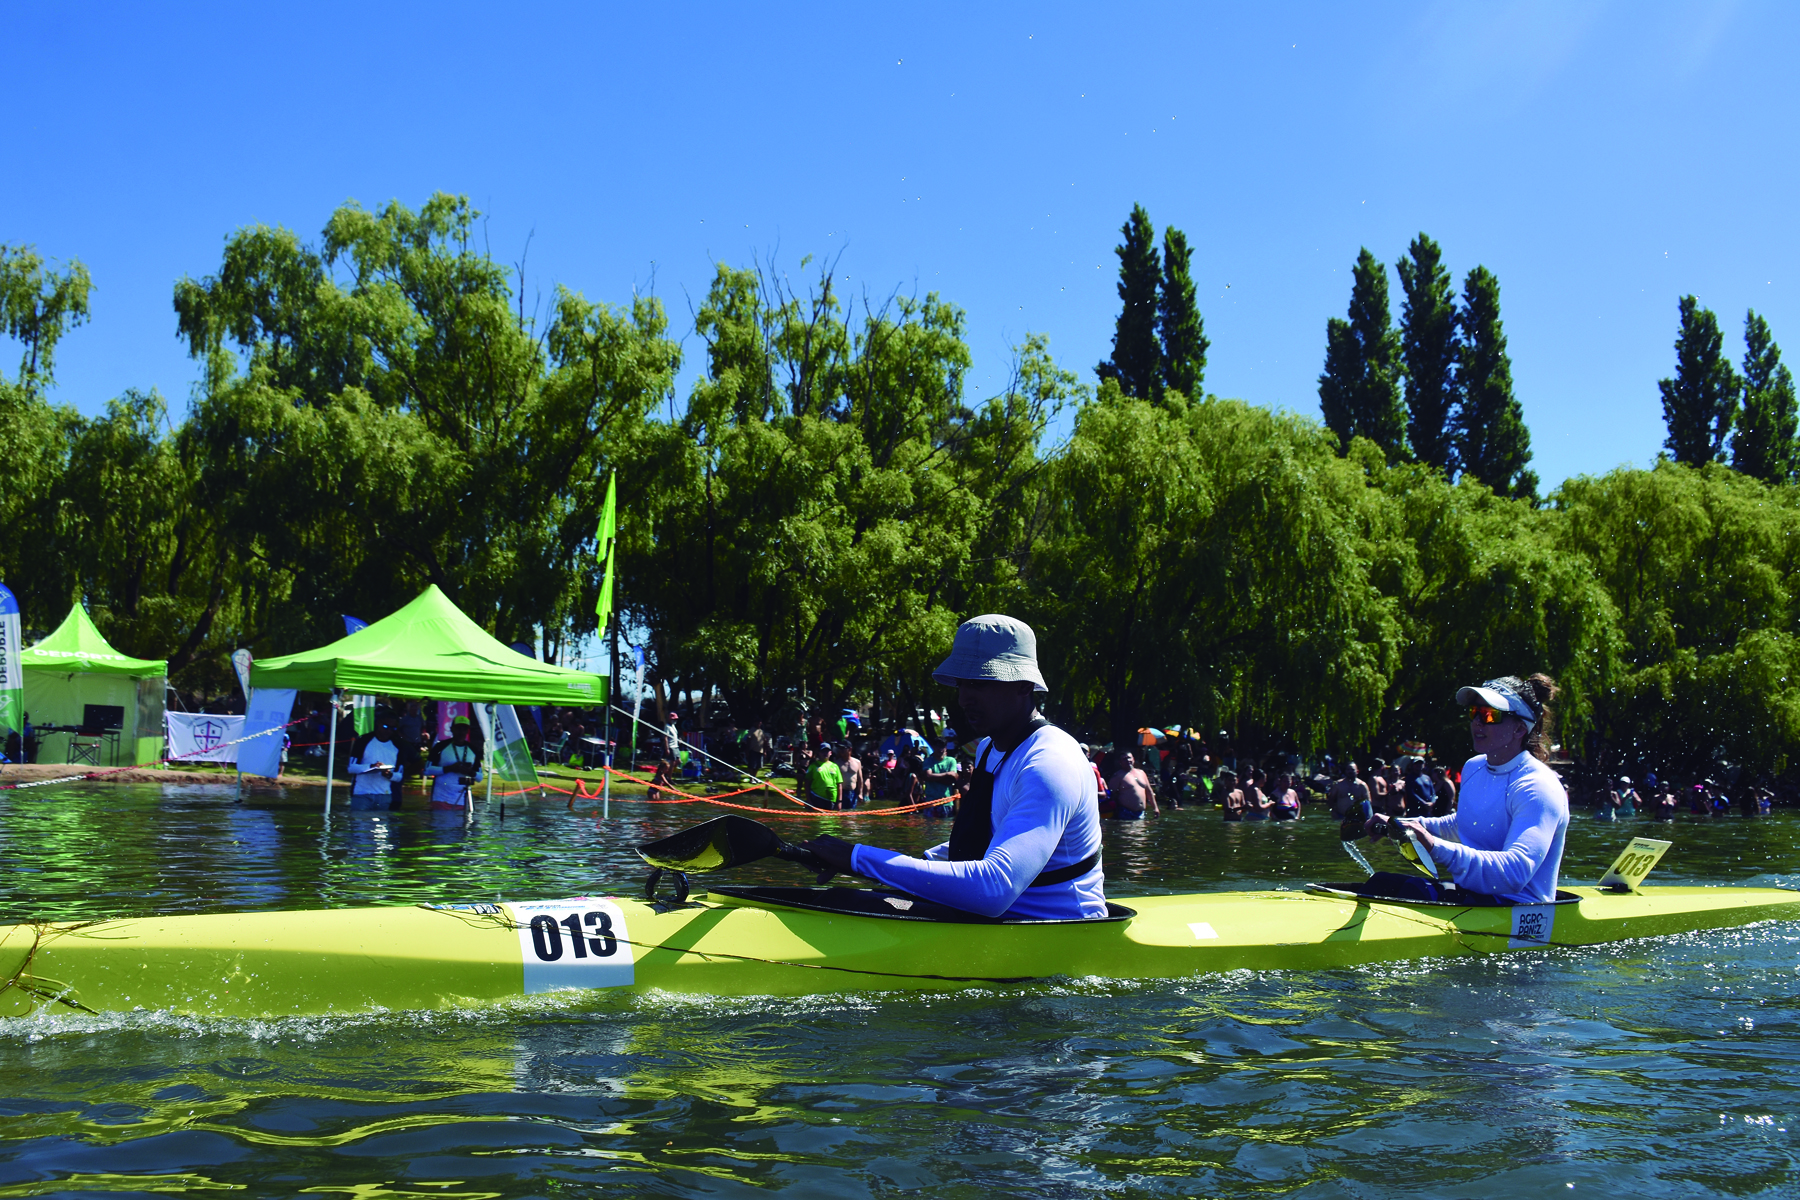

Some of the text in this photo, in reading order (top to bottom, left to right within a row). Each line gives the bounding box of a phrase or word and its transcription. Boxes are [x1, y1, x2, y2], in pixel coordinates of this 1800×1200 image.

[33, 649, 126, 661] DEPORTE
[1614, 853, 1655, 877] 013
[1519, 913, 1544, 925] AGRO
[530, 911, 618, 962] 013
